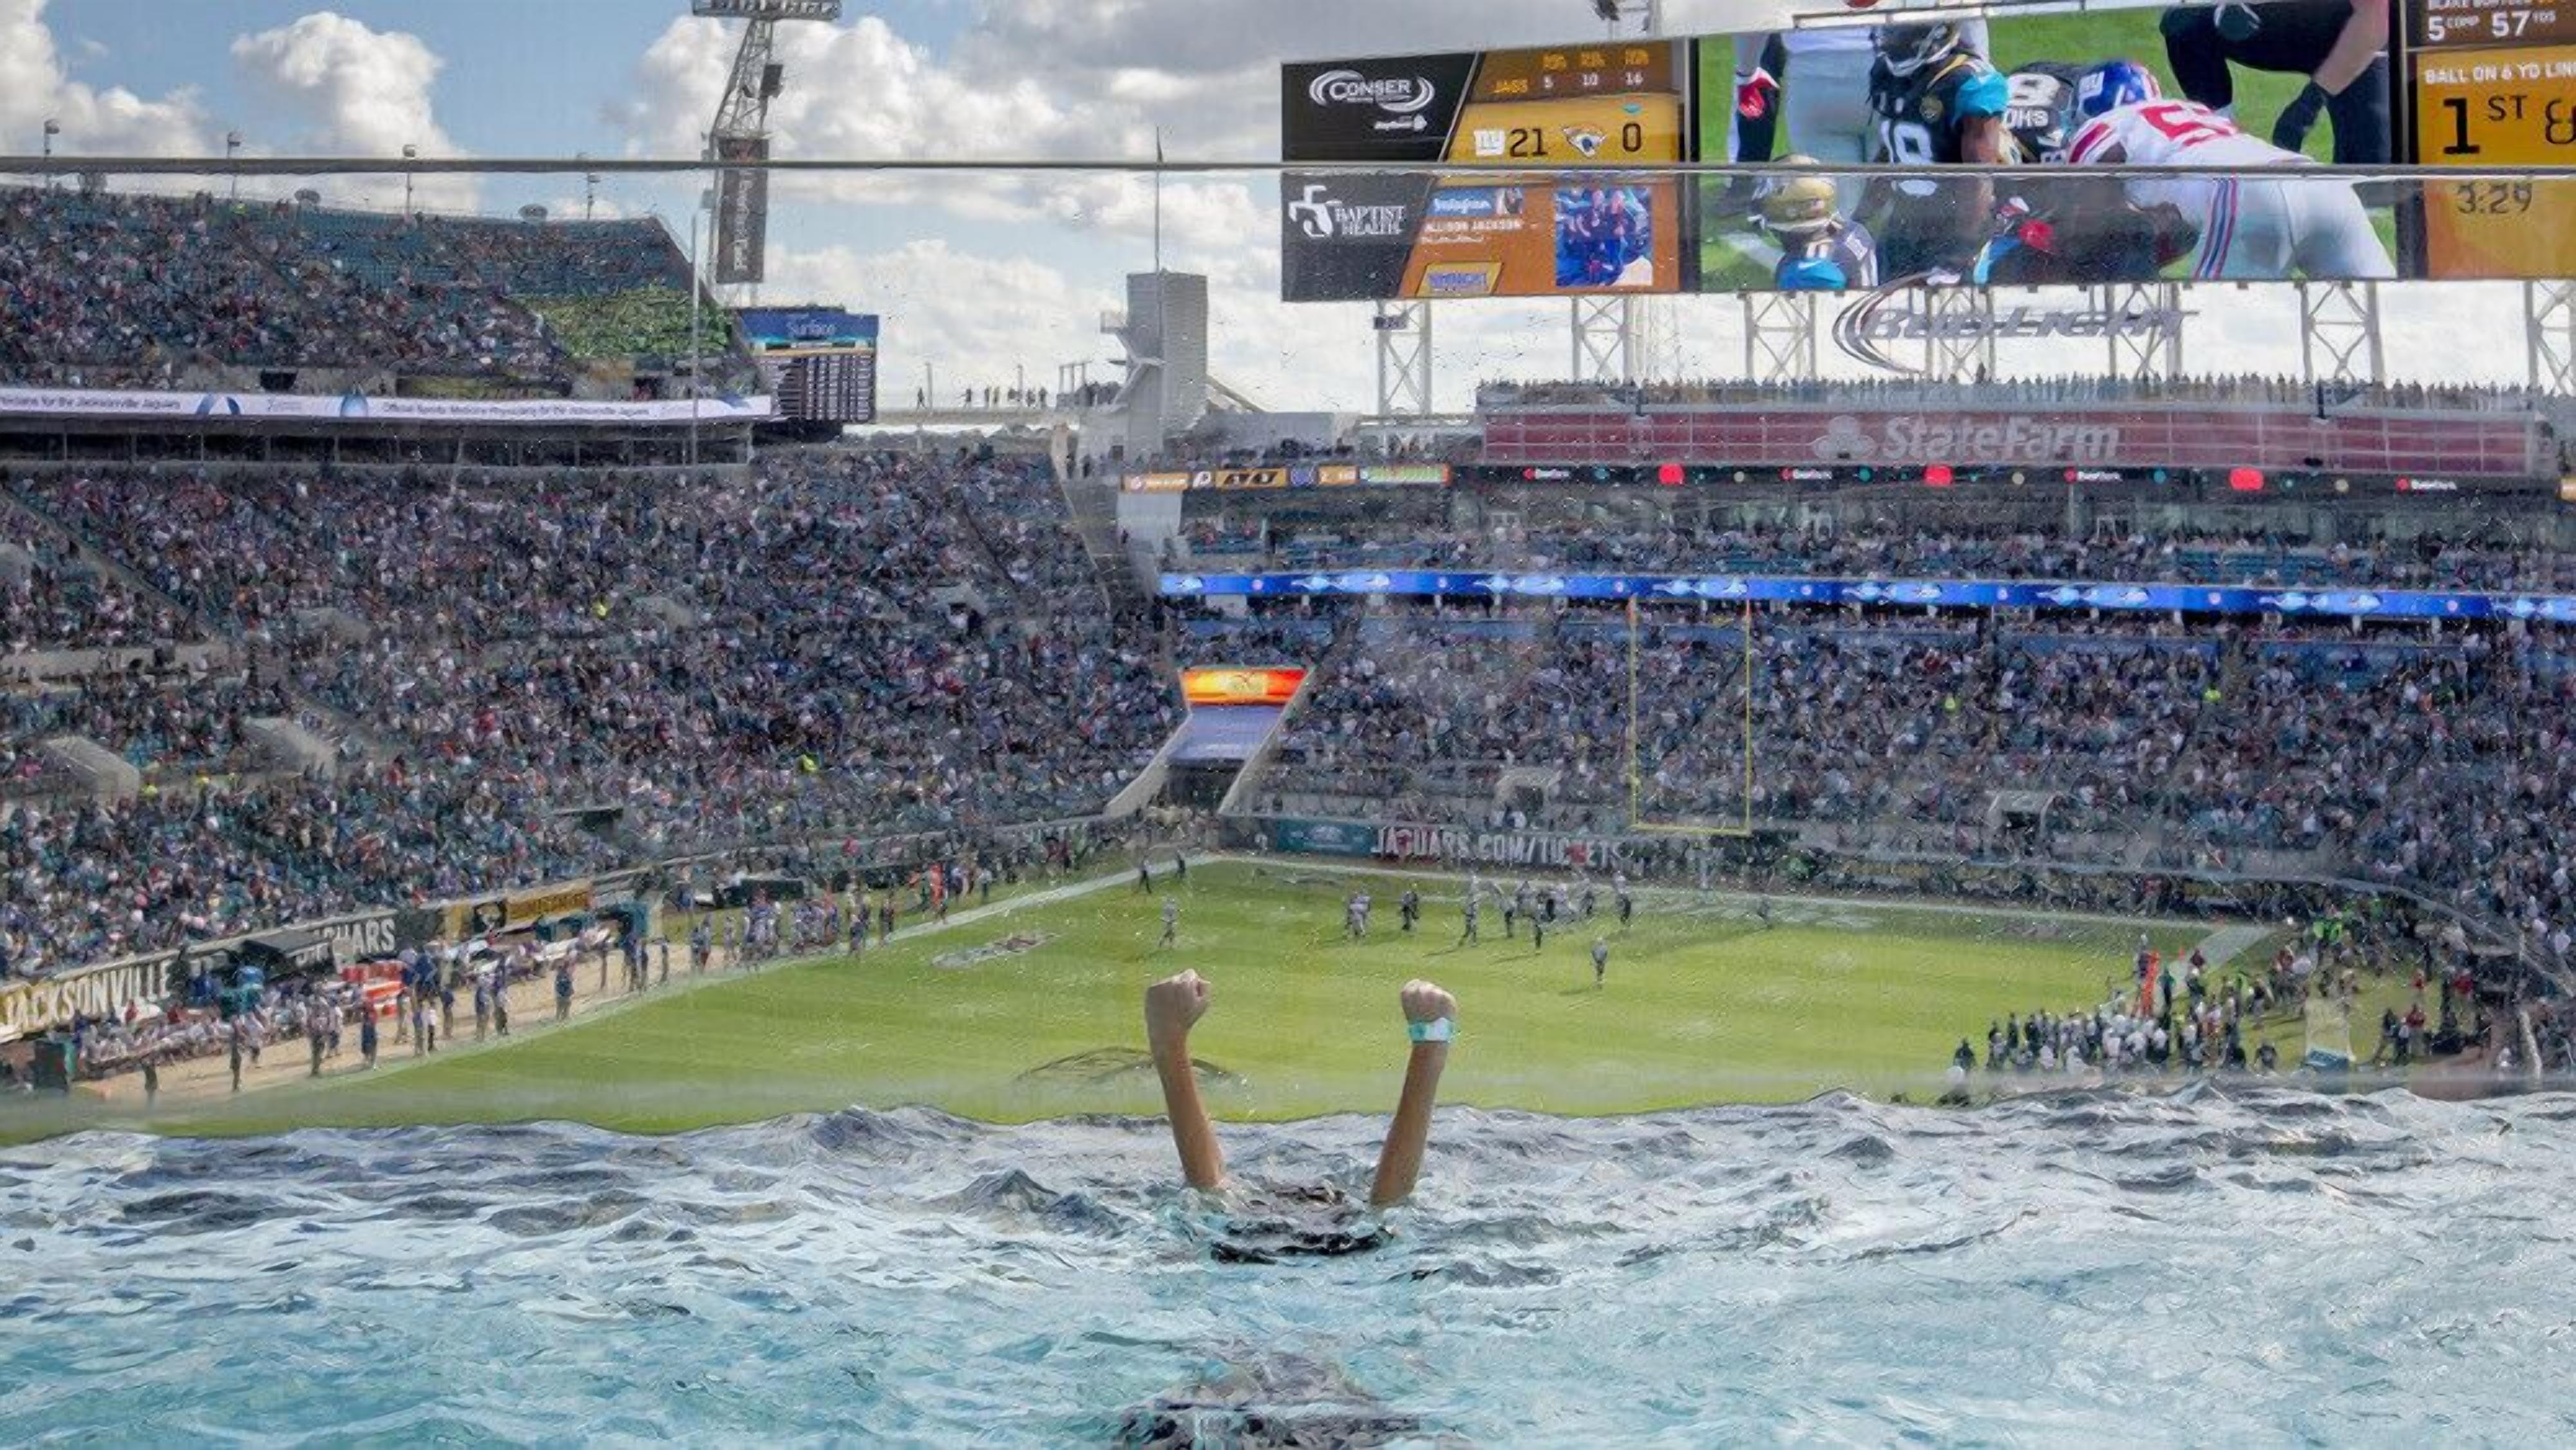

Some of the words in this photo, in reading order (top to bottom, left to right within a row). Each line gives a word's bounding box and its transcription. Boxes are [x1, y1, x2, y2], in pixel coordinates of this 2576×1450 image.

[2428, 16, 2445, 41] 5
[2492, 10, 2532, 37] 57
[2425, 69, 2467, 84] BALL
[2473, 66, 2497, 82] ON
[2517, 62, 2541, 79] YD
[1329, 79, 1411, 100] CONSER
[1510, 129, 1548, 156] 21
[1622, 123, 1641, 152] 0
